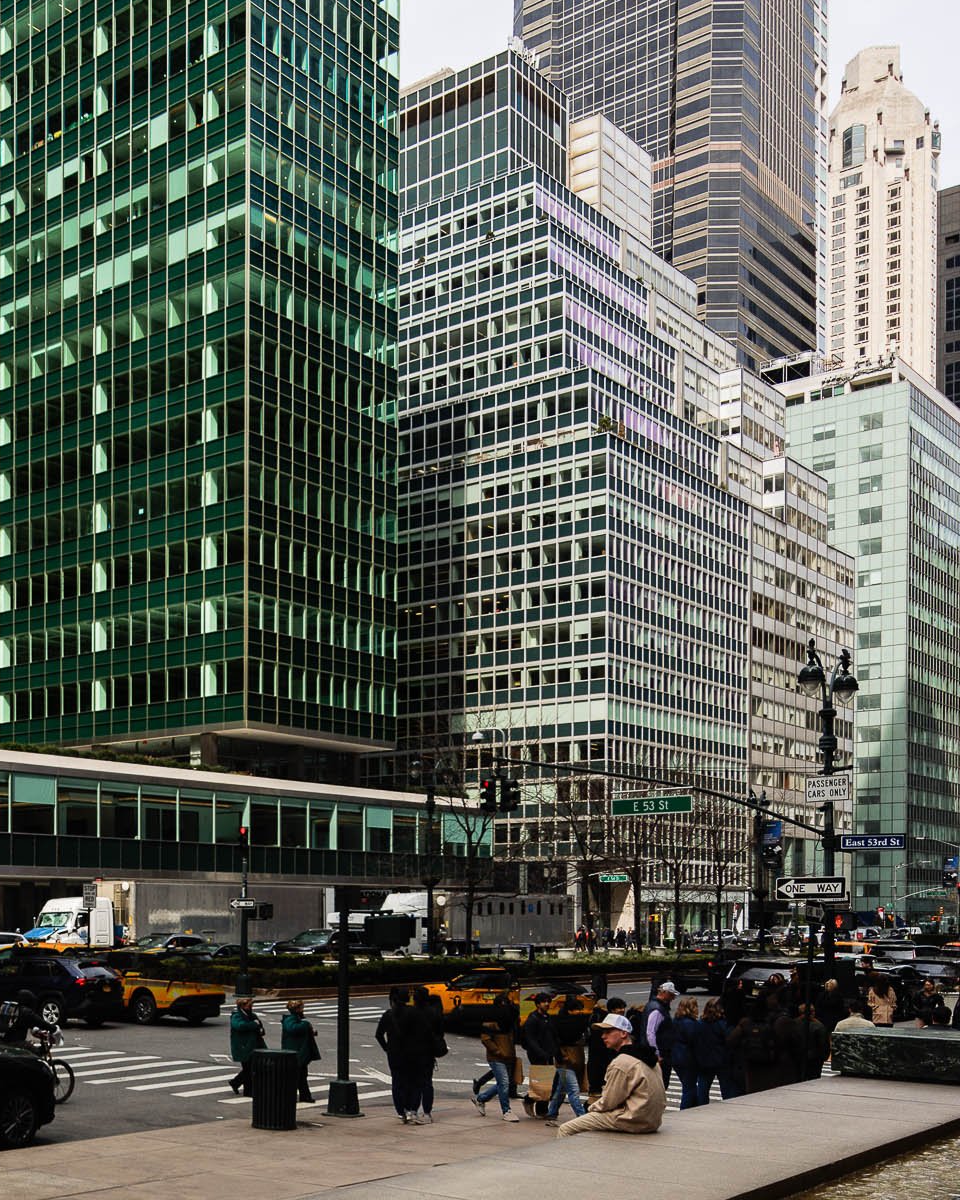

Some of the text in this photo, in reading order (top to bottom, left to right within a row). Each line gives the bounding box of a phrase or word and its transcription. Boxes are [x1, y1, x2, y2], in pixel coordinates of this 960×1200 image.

[808, 778, 846, 788] PASSENGER
[808, 788, 847, 798] CARS ONLY
[633, 800, 669, 812] E 53 St
[845, 838, 900, 847] East 53rd St
[785, 884, 840, 893] ONE WAY
